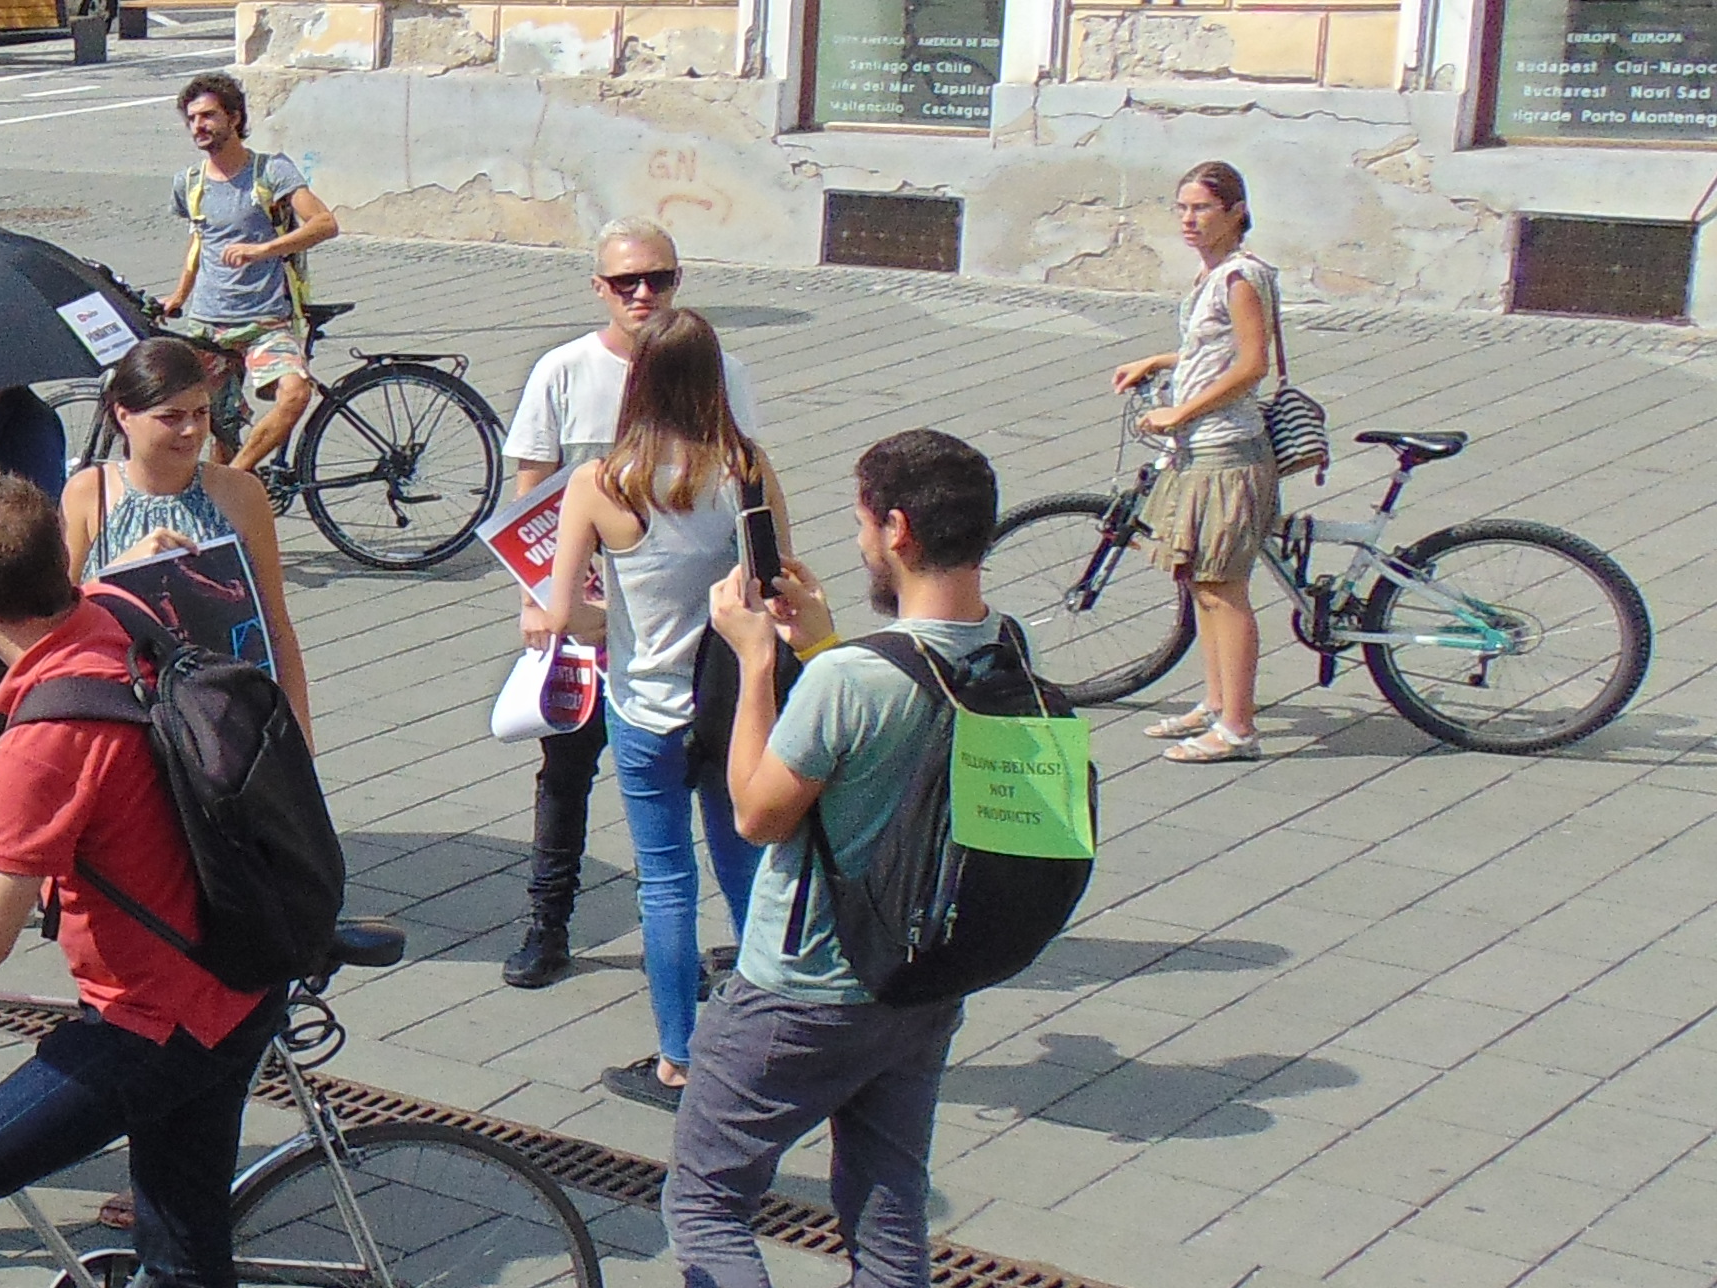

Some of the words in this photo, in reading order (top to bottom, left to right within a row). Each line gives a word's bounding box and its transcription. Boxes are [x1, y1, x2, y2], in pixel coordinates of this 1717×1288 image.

[849, 60, 907, 74] Santiago
[912, 62, 931, 73] de
[936, 62, 972, 74] Chile
[1516, 61, 1599, 75] Budapest
[1614, 61, 1717, 75] Cluj-Napoc
[933, 83, 991, 99] Zapallar
[1523, 85, 1607, 98] Bucharest
[1630, 85, 1671, 99] Novi
[1676, 85, 1711, 99] Sad
[1581, 110, 1626, 123] Porto
[1631, 110, 1717, 127] Monteneg
[517, 505, 559, 545] CINA
[989, 783, 1015, 799] NOT
[976, 804, 1042, 825] PRODUCTS
